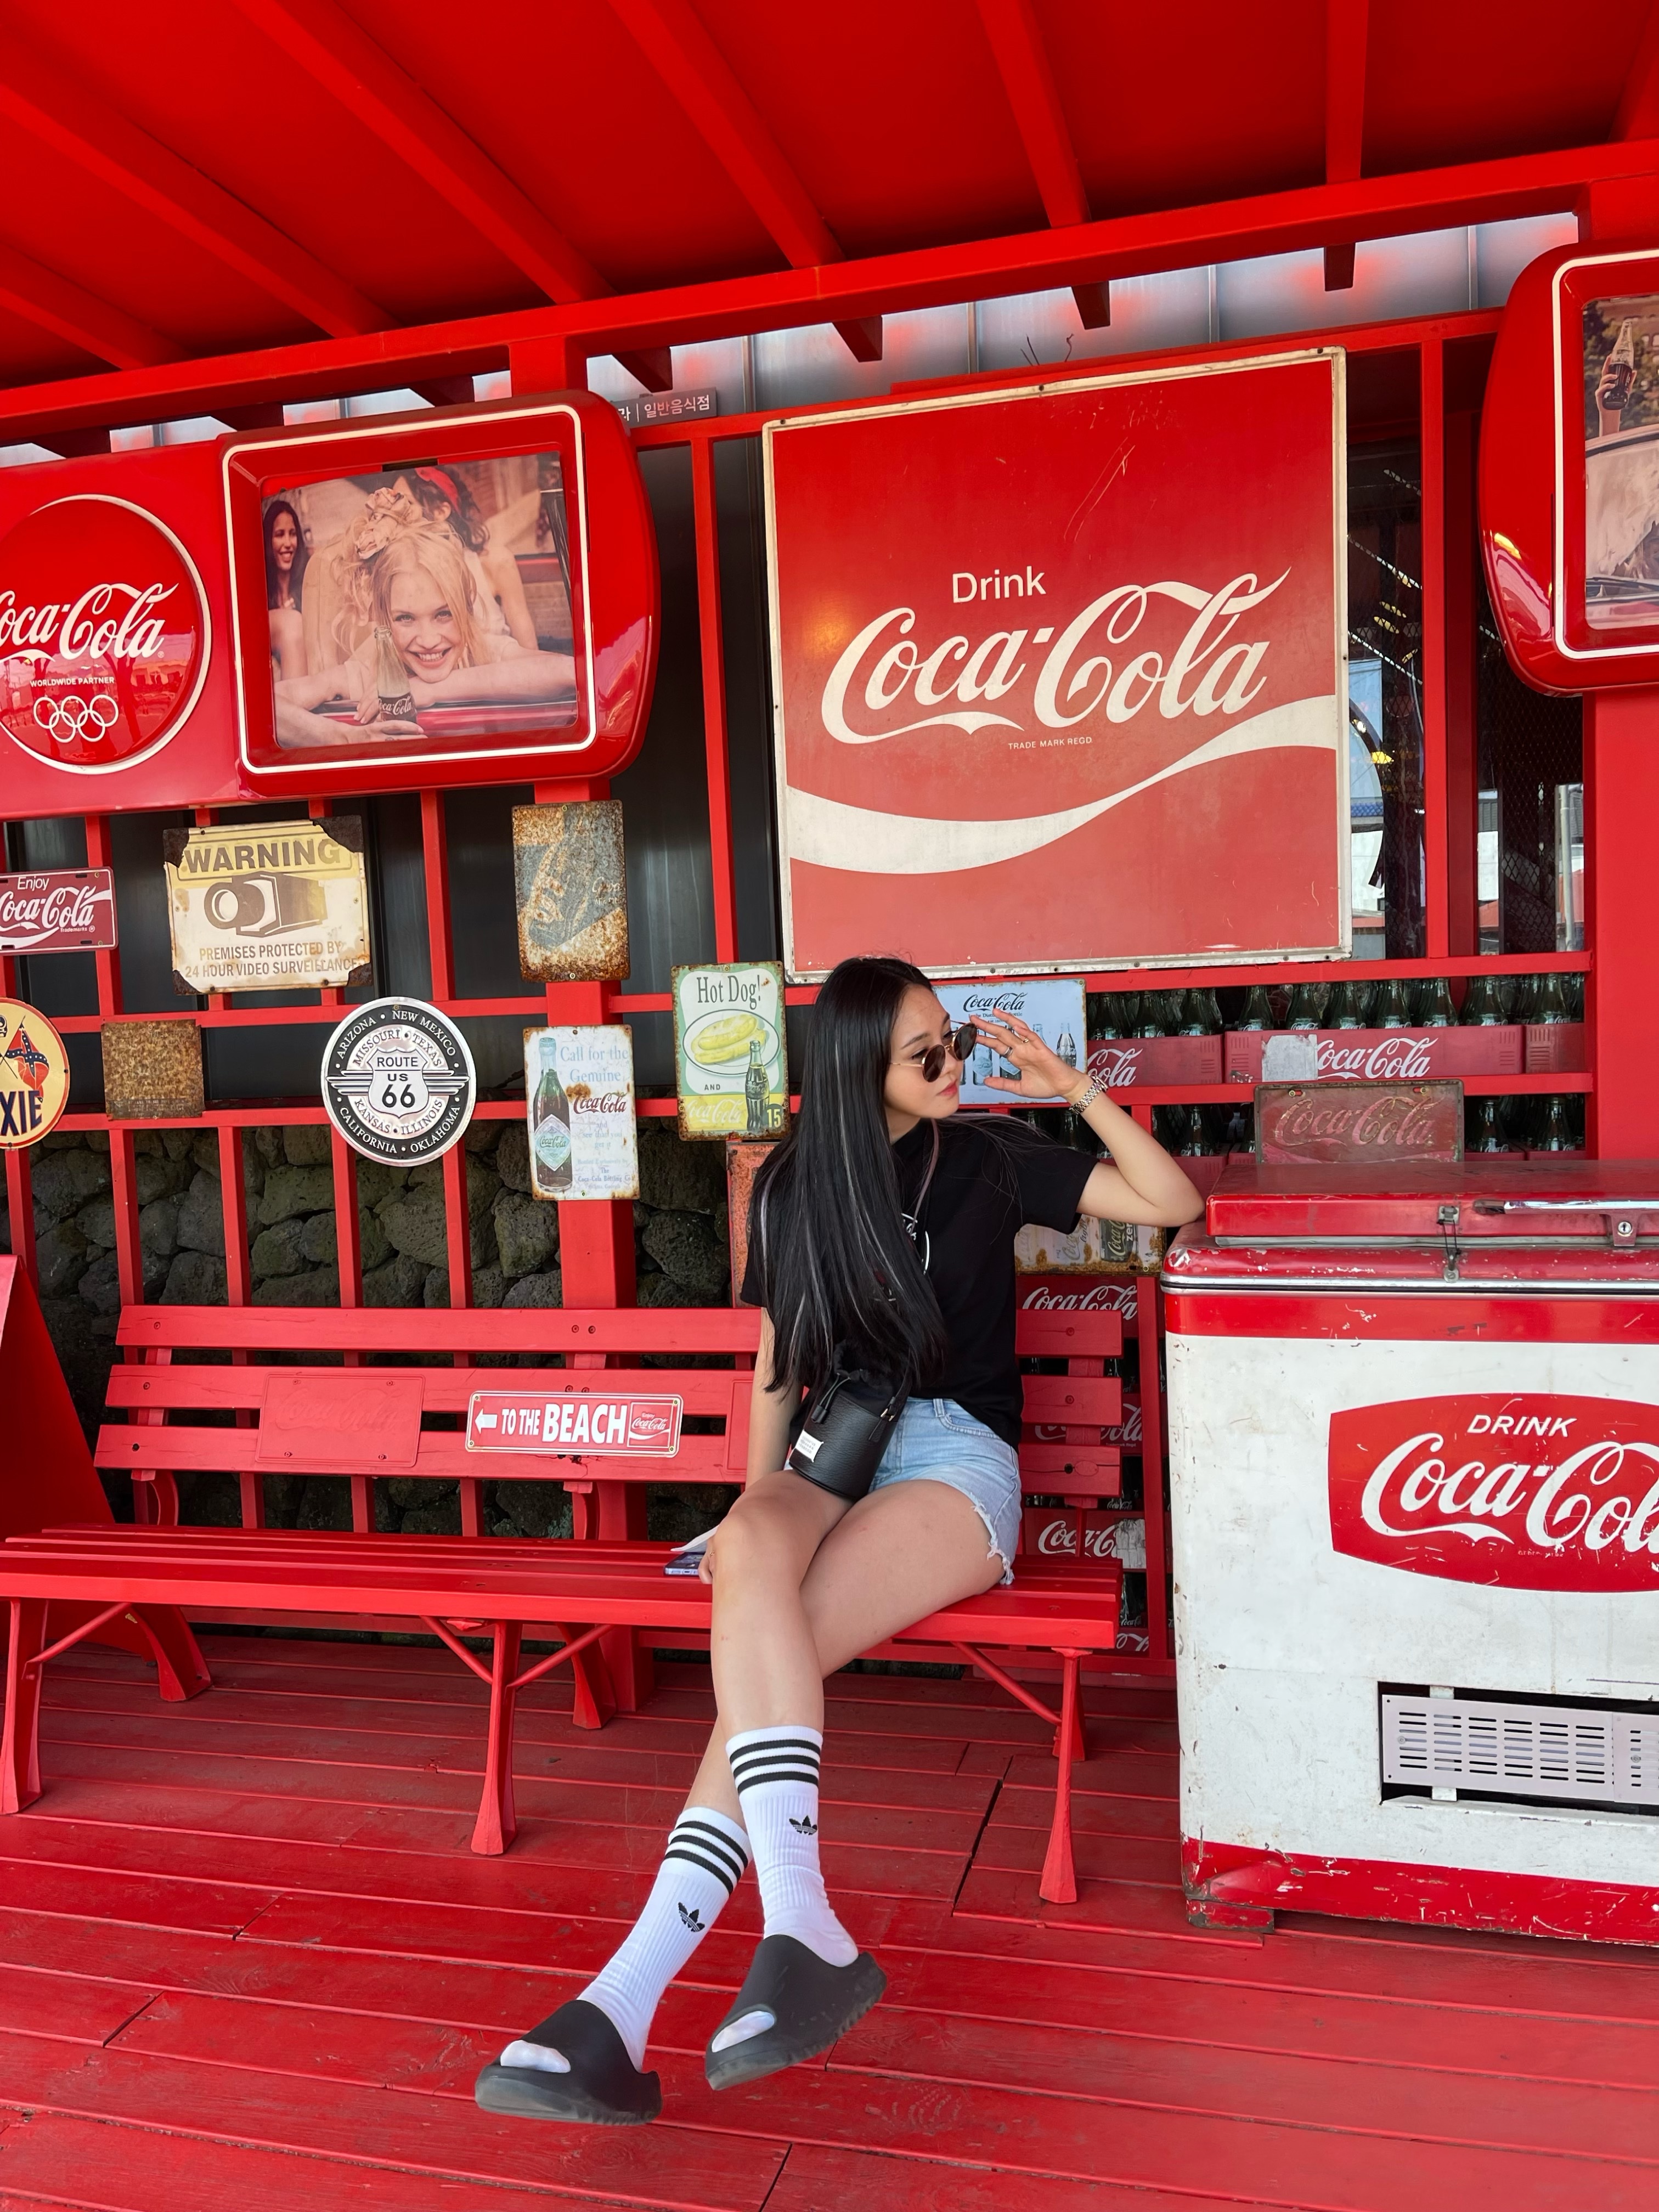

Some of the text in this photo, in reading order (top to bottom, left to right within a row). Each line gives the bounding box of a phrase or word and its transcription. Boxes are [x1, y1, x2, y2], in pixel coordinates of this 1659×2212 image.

[644, 394, 710, 419] 일반음식점
[952, 566, 1047, 603] Drink
[821, 566, 1292, 744] Coca-Cola
[30, 676, 115, 687] WORLDWIDE PARTNER
[1008, 741, 1036, 750] TRADE
[1040, 738, 1065, 748] MARK
[184, 838, 341, 873] WARNING
[17, 876, 50, 891] Enjoy
[199, 941, 342, 961] PREMISES PROTECTED BY
[185, 964, 200, 978] 24
[202, 963, 234, 978] HOUR
[236, 961, 269, 976] VIDEO
[696, 974, 761, 1010] Hot Dog!
[963, 992, 1028, 1012] Coca-Cola
[338, 1010, 456, 1060] ARIZONA NEW MEXICO
[352, 1029, 442, 1066] MISSOURI TEXAS
[560, 1045, 629, 1062] Call for the
[376, 1057, 419, 1067] ROUTE
[387, 1073, 409, 1082] US
[569, 1069, 621, 1083] Genuine
[381, 1084, 416, 1108] 66
[573, 1092, 629, 1114] Coca-Cola
[354, 1098, 443, 1135] KANSAS ILLINOIS
[1274, 1097, 1444, 1147] Coca-Cola
[340, 1105, 461, 1154] CALIFORNIA OKLAHOMA
[501, 1403, 628, 1444] TO THE BEACH
[631, 1417, 669, 1430] Coca-Cola
[1467, 1414, 1578, 1437] DRINK
[1361, 1433, 1659, 1555] Coca-Col
